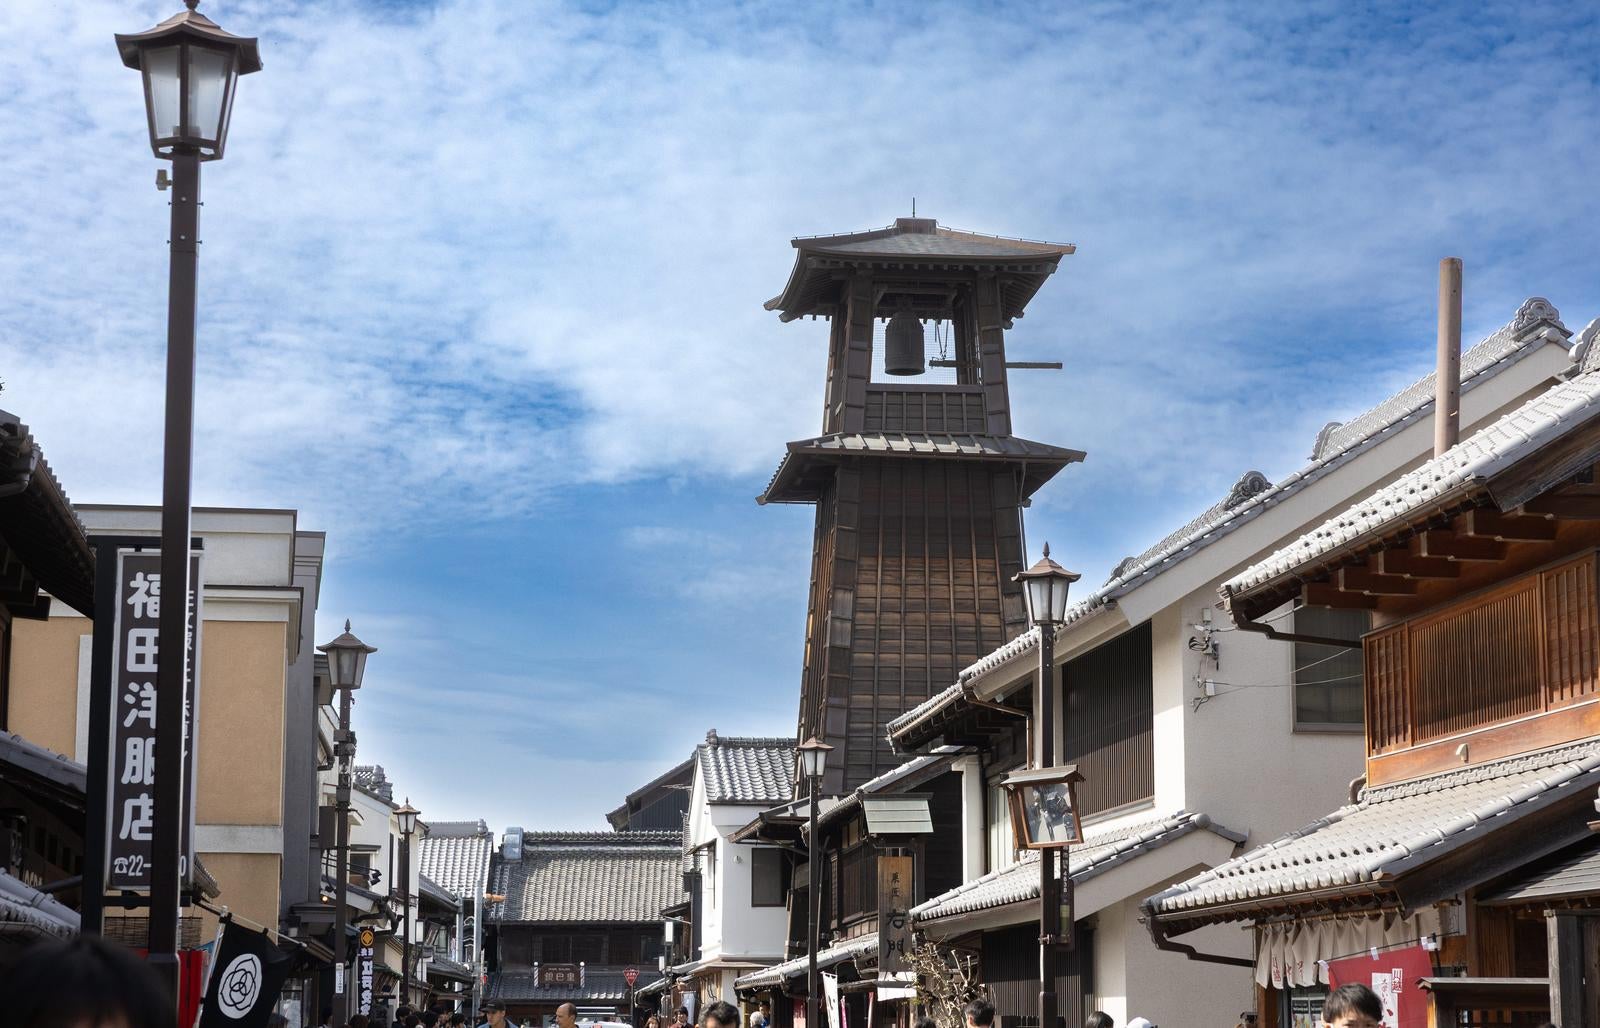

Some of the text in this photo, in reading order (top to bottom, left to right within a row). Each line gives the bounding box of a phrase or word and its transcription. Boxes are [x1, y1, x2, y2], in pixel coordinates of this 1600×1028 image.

[119, 571, 162, 841] 福田洋服店
